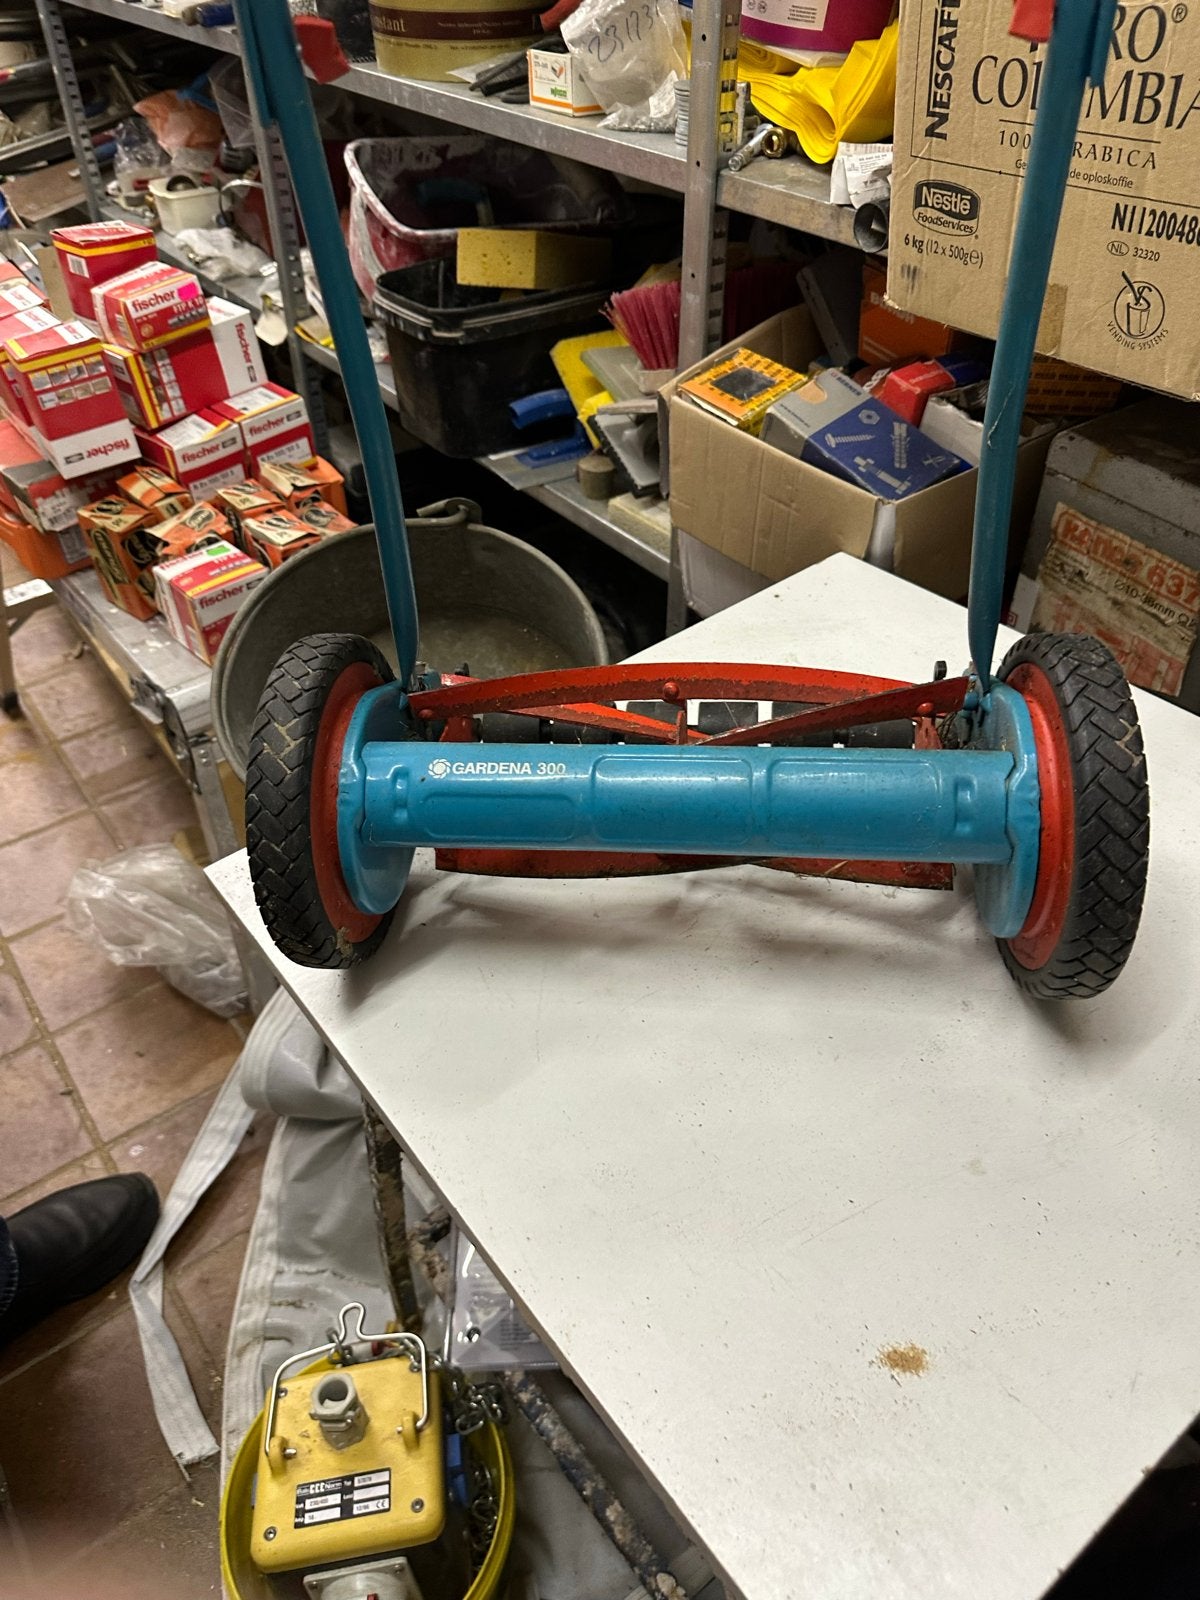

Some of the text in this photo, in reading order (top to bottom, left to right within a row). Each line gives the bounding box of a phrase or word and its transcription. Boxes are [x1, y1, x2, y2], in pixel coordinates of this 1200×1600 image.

[924, 0, 961, 141] NESCAF
[998, 129, 1157, 170] 100 RABICA
[1082, 171, 1134, 189] oploskoffie
[917, 211, 975, 234] FoodServices
[1111, 202, 1200, 247] N1120048
[904, 233, 910, 246] 6
[912, 235, 924, 254] kg
[1132, 246, 1161, 262] 32320
[132, 289, 176, 313] fischer
[235, 322, 253, 364] fischer
[1106, 320, 1169, 351] VENDING SYSTEMS
[249, 416, 286, 437] fischer
[85, 437, 132, 460] fischer
[181, 442, 222, 465] fischer
[198, 584, 245, 610] fischer
[452, 762, 567, 776] GARDENA 300
